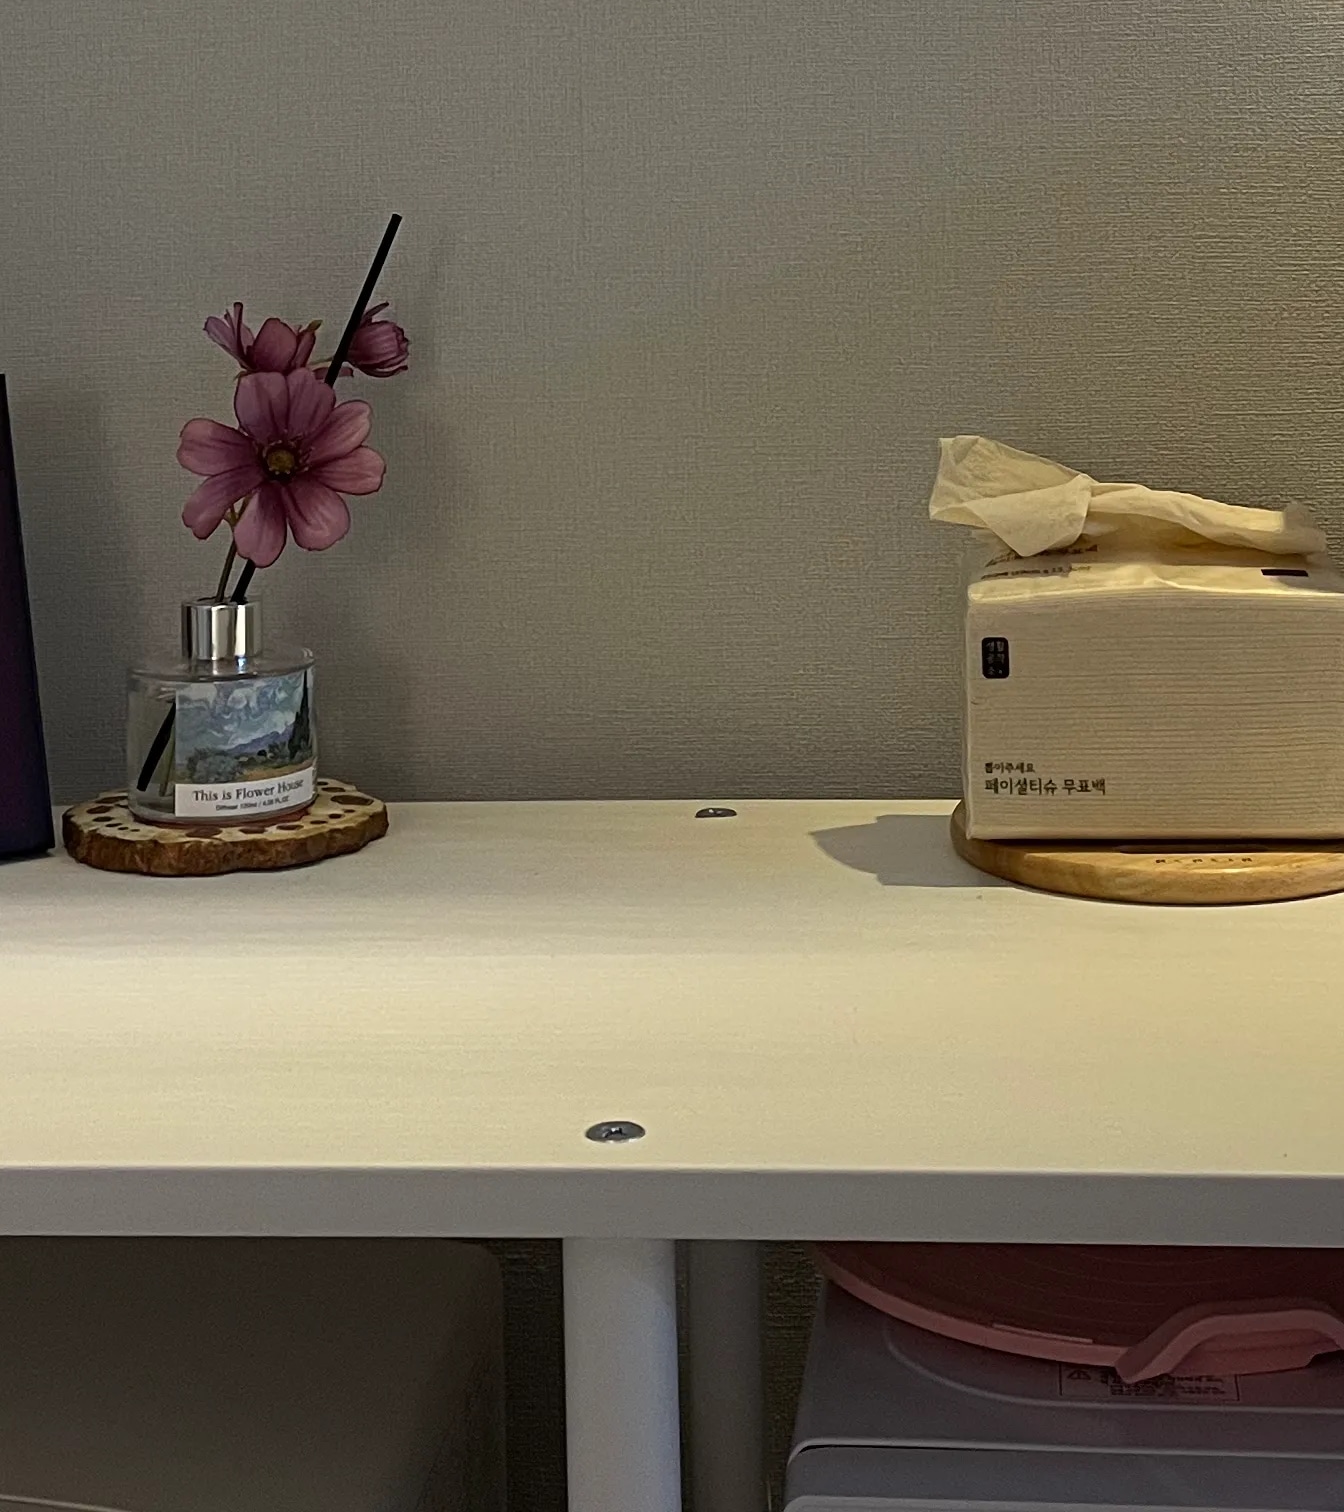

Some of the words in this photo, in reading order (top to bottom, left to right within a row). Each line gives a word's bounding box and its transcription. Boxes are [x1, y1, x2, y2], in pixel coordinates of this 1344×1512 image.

[192, 789, 218, 802] This
[222, 789, 232, 801] is
[235, 786, 276, 801] Flower
[276, 779, 304, 794] House
[984, 777, 1058, 797] 페이셜티슈
[1061, 777, 1106, 796] 무표백
